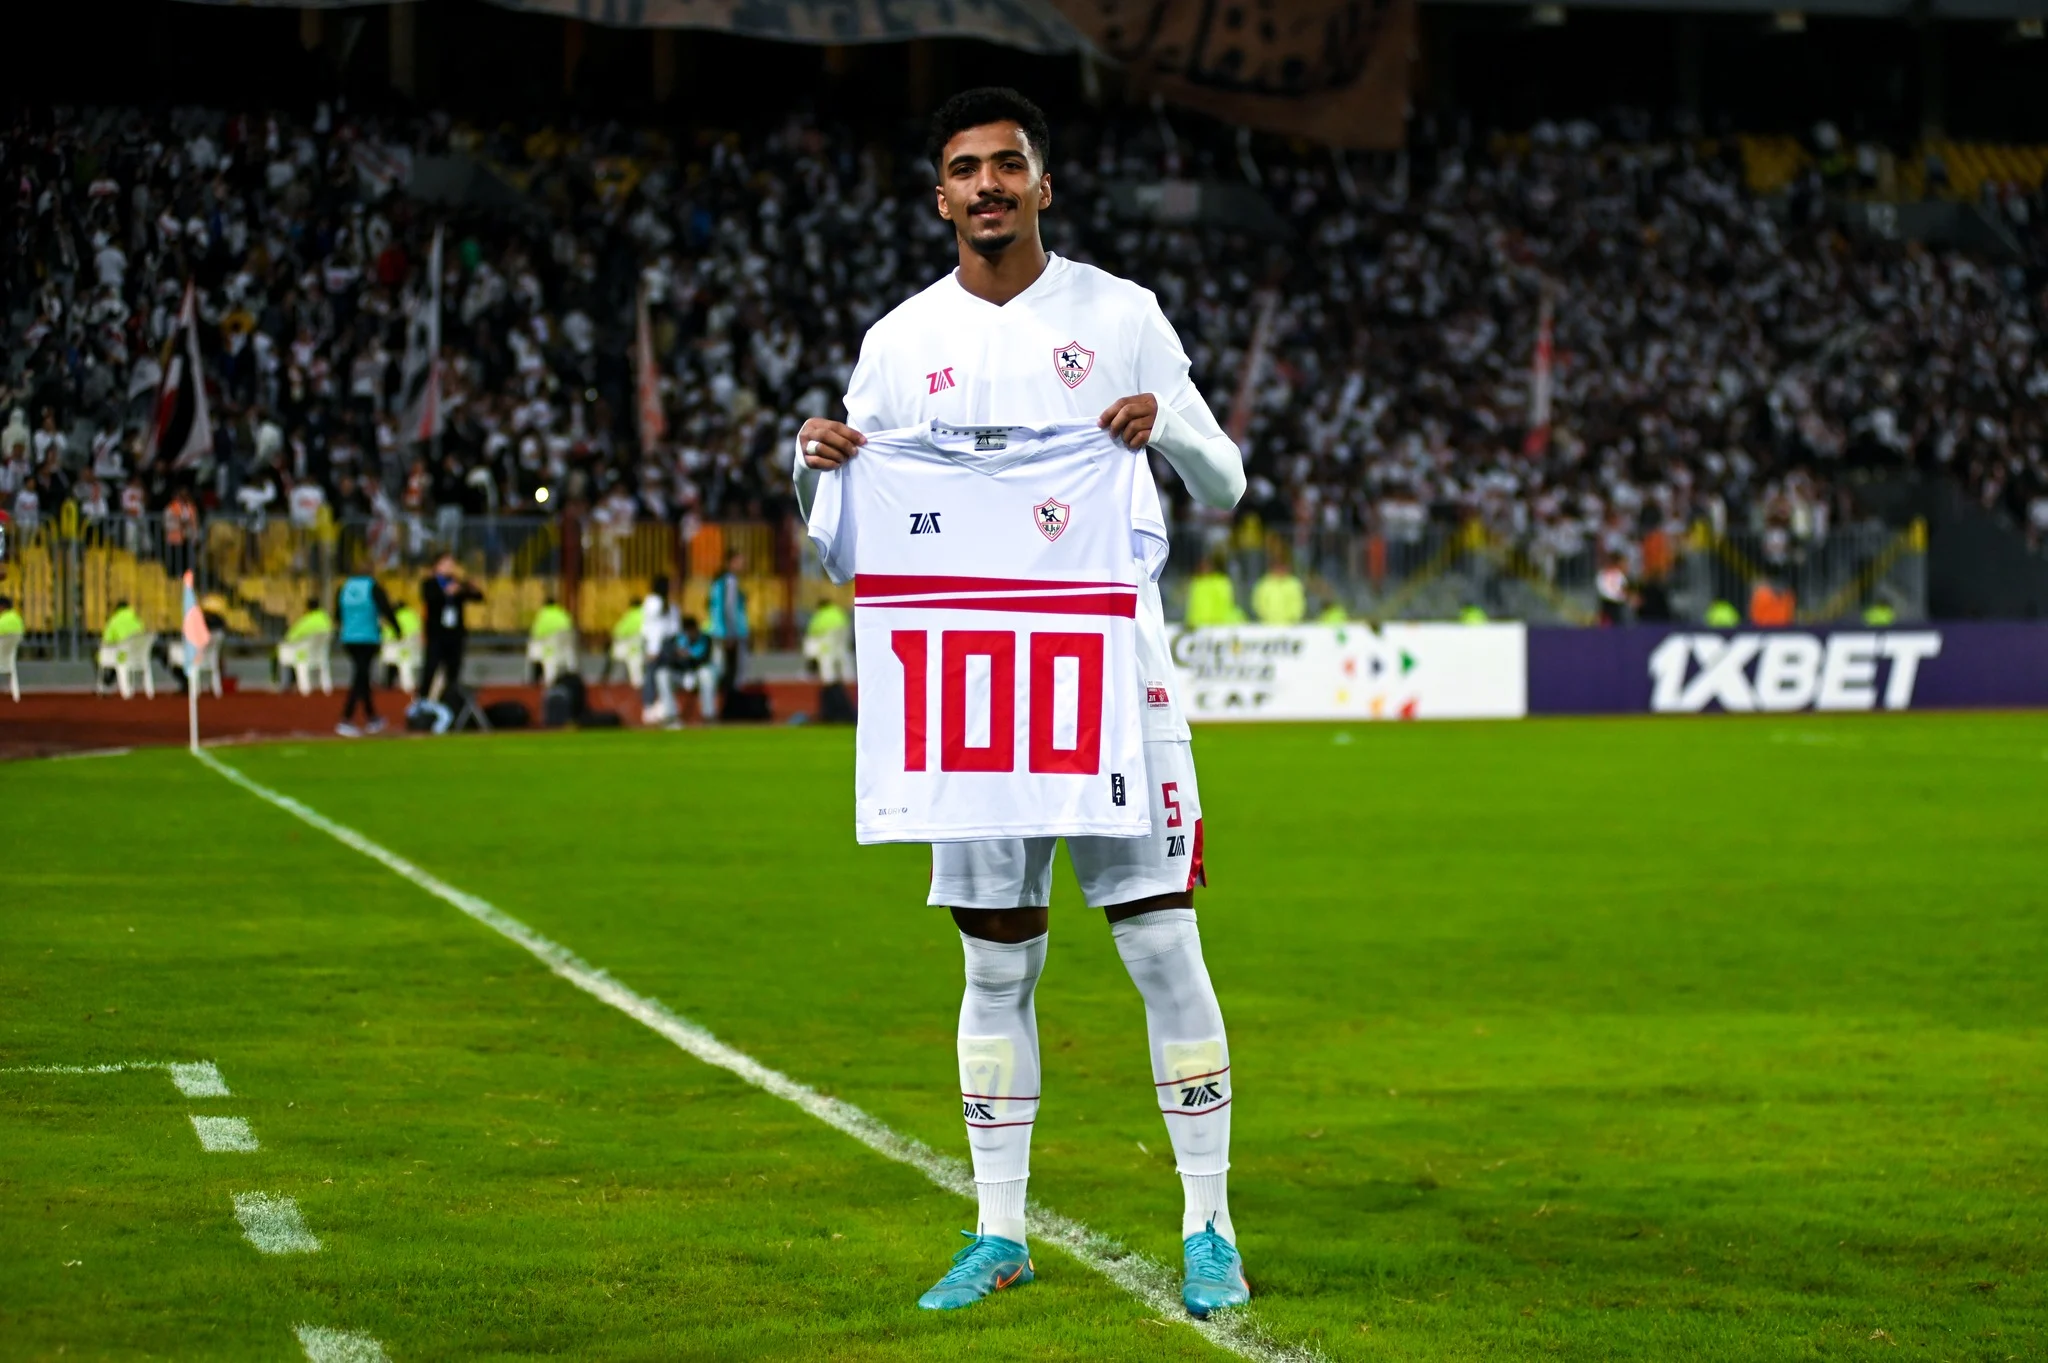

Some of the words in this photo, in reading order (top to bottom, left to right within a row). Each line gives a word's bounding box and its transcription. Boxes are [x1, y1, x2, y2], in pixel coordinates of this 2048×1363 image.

[891, 630, 1104, 774] 100
[1649, 632, 1943, 711] 1XBET
[1161, 781, 1182, 828] 5
